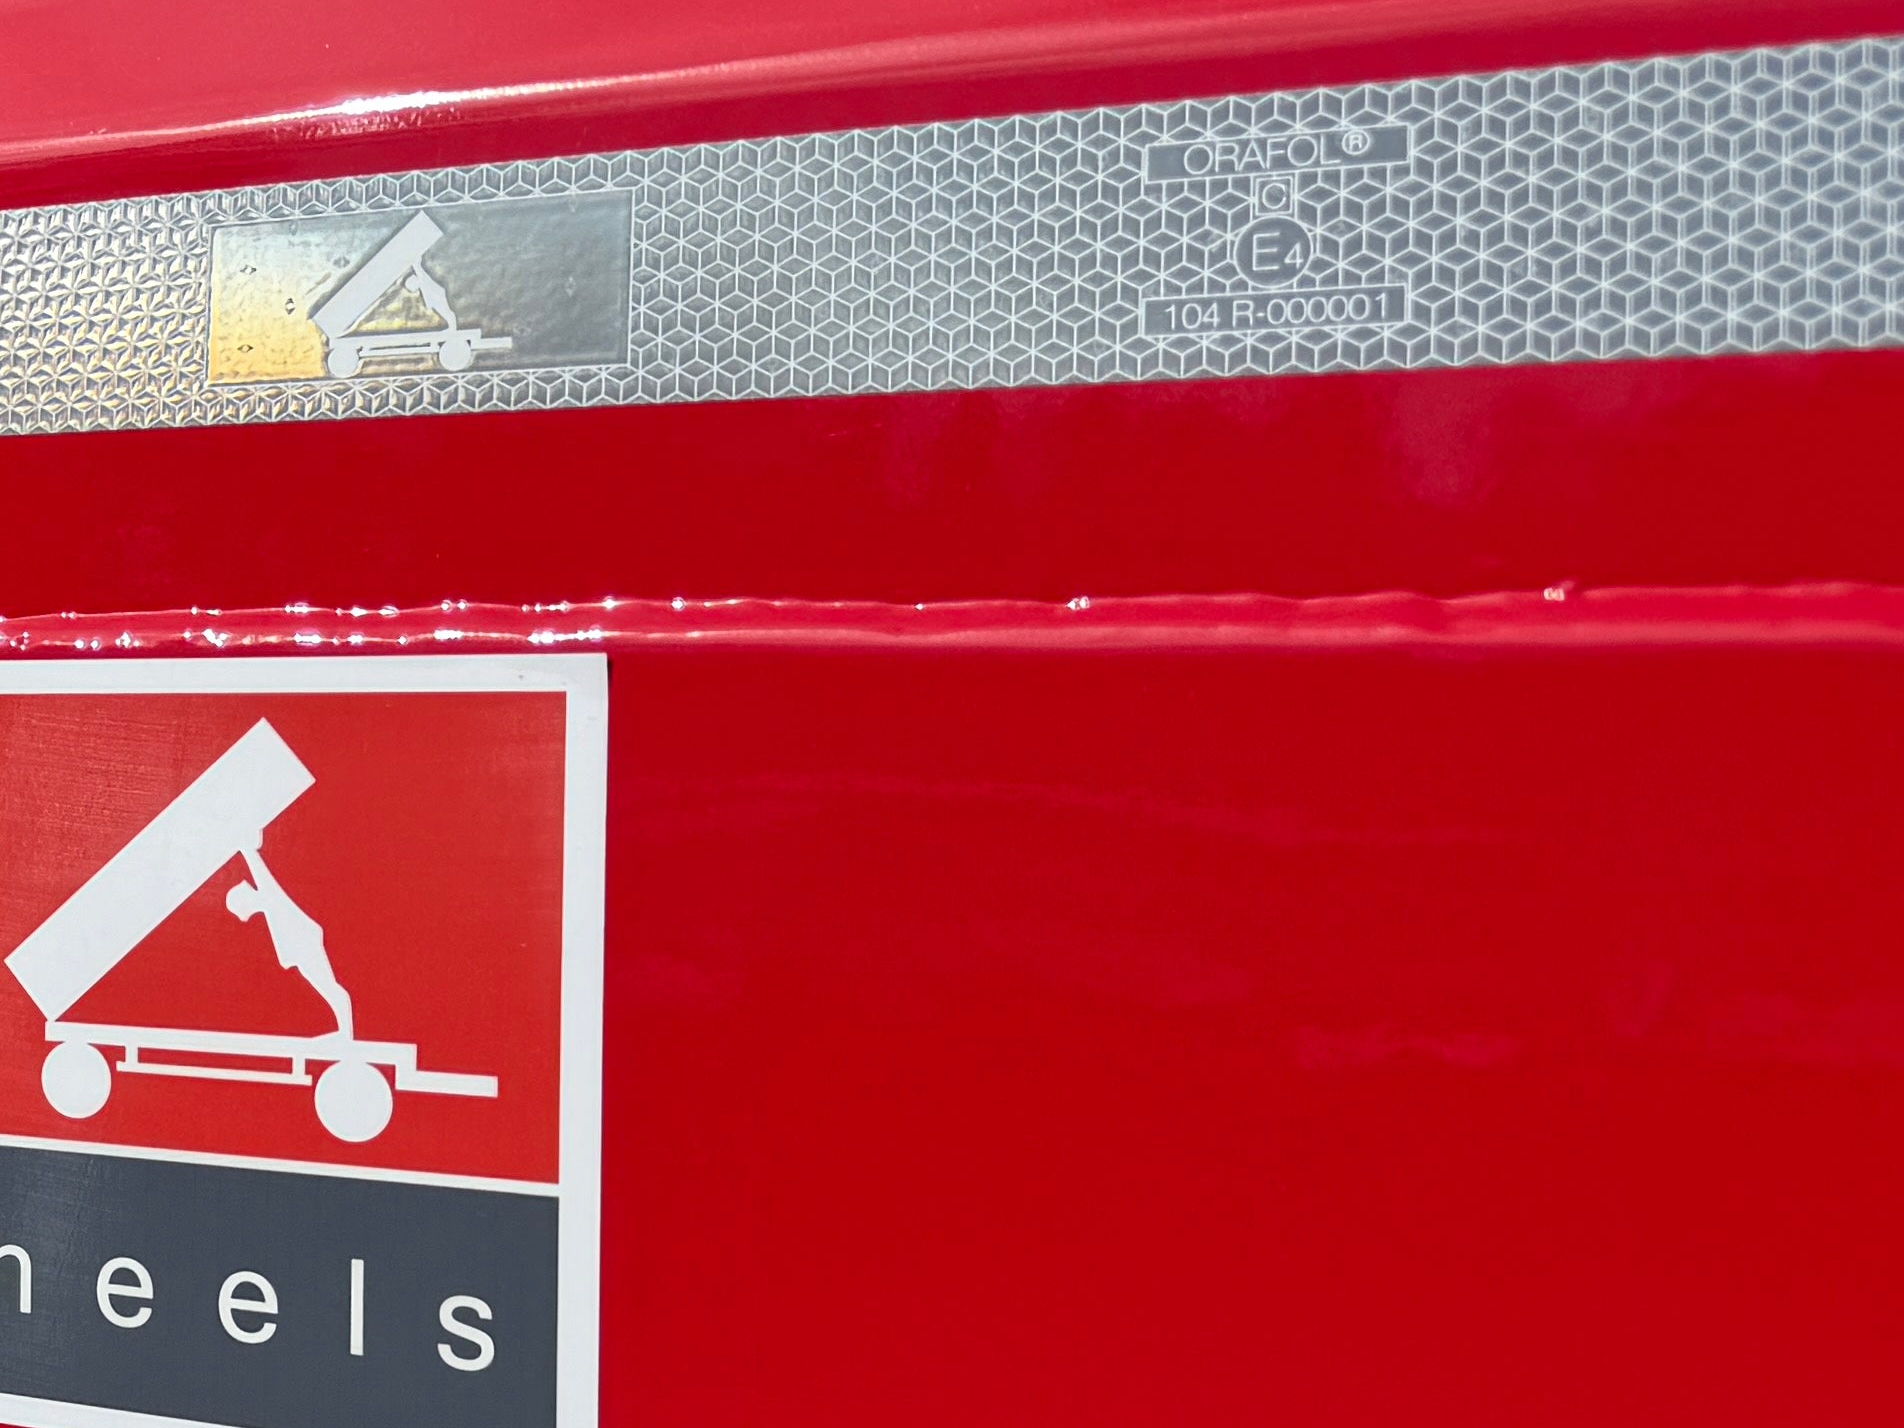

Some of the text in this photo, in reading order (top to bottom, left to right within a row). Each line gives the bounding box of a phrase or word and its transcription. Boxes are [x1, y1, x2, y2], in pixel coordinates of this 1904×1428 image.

[1261, 183, 1287, 210] C
[1251, 232, 1305, 272] E4
[1164, 291, 1388, 330] 104 R-000001
